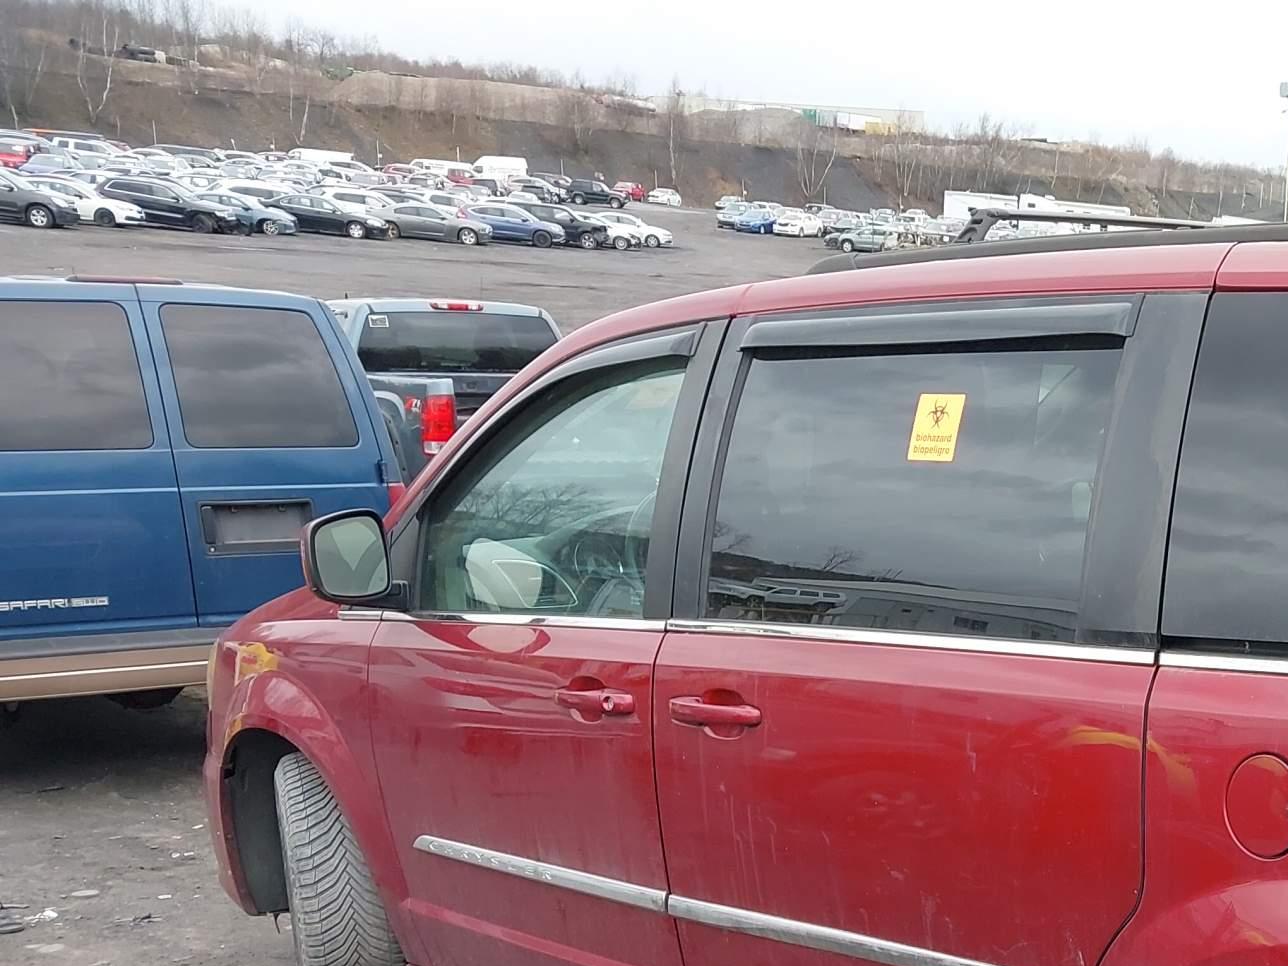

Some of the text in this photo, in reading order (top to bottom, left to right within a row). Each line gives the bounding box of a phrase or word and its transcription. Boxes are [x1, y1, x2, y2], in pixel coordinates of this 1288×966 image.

[915, 434, 953, 442] biohazard
[912, 446, 950, 456] biopeligro
[0, 598, 68, 611] SAFARI
